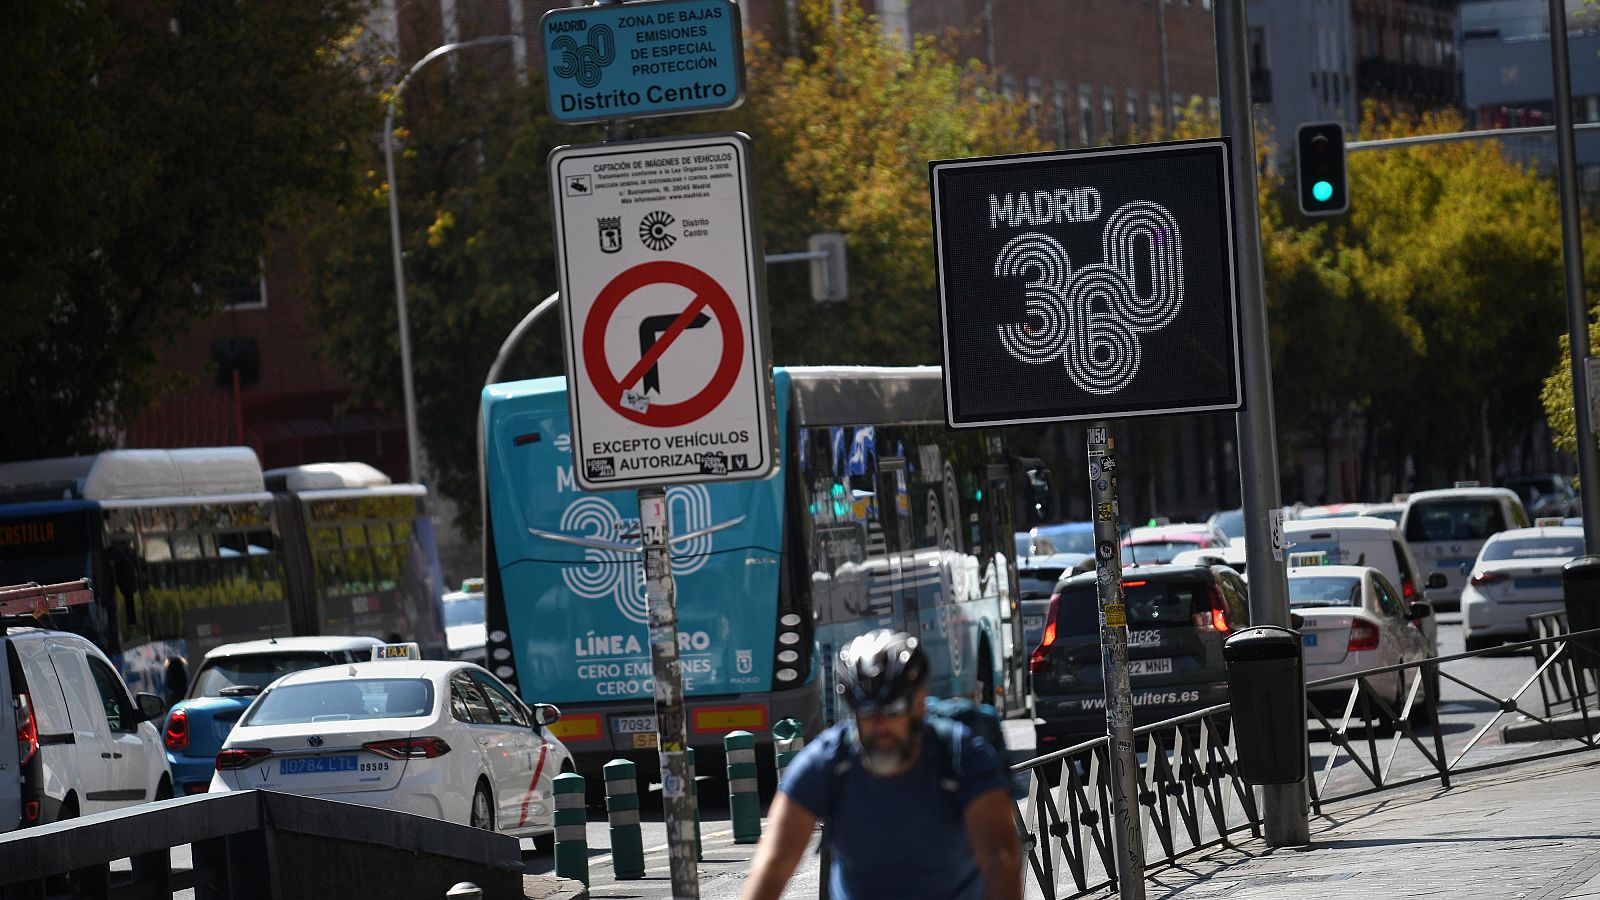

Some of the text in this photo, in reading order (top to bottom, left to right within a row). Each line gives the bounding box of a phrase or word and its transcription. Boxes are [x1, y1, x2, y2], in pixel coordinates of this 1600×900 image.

[548, 19, 588, 34] MADRID
[618, 7, 723, 29] ZONA DE BAJAS
[636, 25, 708, 43] EMISIONES
[551, 23, 616, 89] 360
[631, 41, 716, 60] DE ESPECIAL
[632, 55, 718, 76] PROTECCIÓN
[560, 80, 727, 112] Distrito Centro
[593, 152, 733, 172] CAPTACIÓN DE IMÁGENES DE VEHÍCULOS
[671, 167, 681, 175] Ley
[683, 164, 708, 173] Orgánica
[988, 185, 1103, 229] MADRID
[682, 218, 710, 227] Distrito
[683, 228, 708, 237] Centro
[994, 199, 1185, 395] 360
[593, 430, 749, 455] EXCEPTO VEHÍCULOS
[387, 645, 409, 657] TAXI
[575, 630, 642, 657] LÍNEA
[577, 659, 712, 680] CERO EMINES
[1128, 659, 1170, 674] 22 MNH
[596, 680, 639, 695] CERO
[621, 718, 651, 731] 7092
[329, 757, 355, 770] LTL
[360, 762, 389, 772] 09505
[260, 765, 271, 782] V
